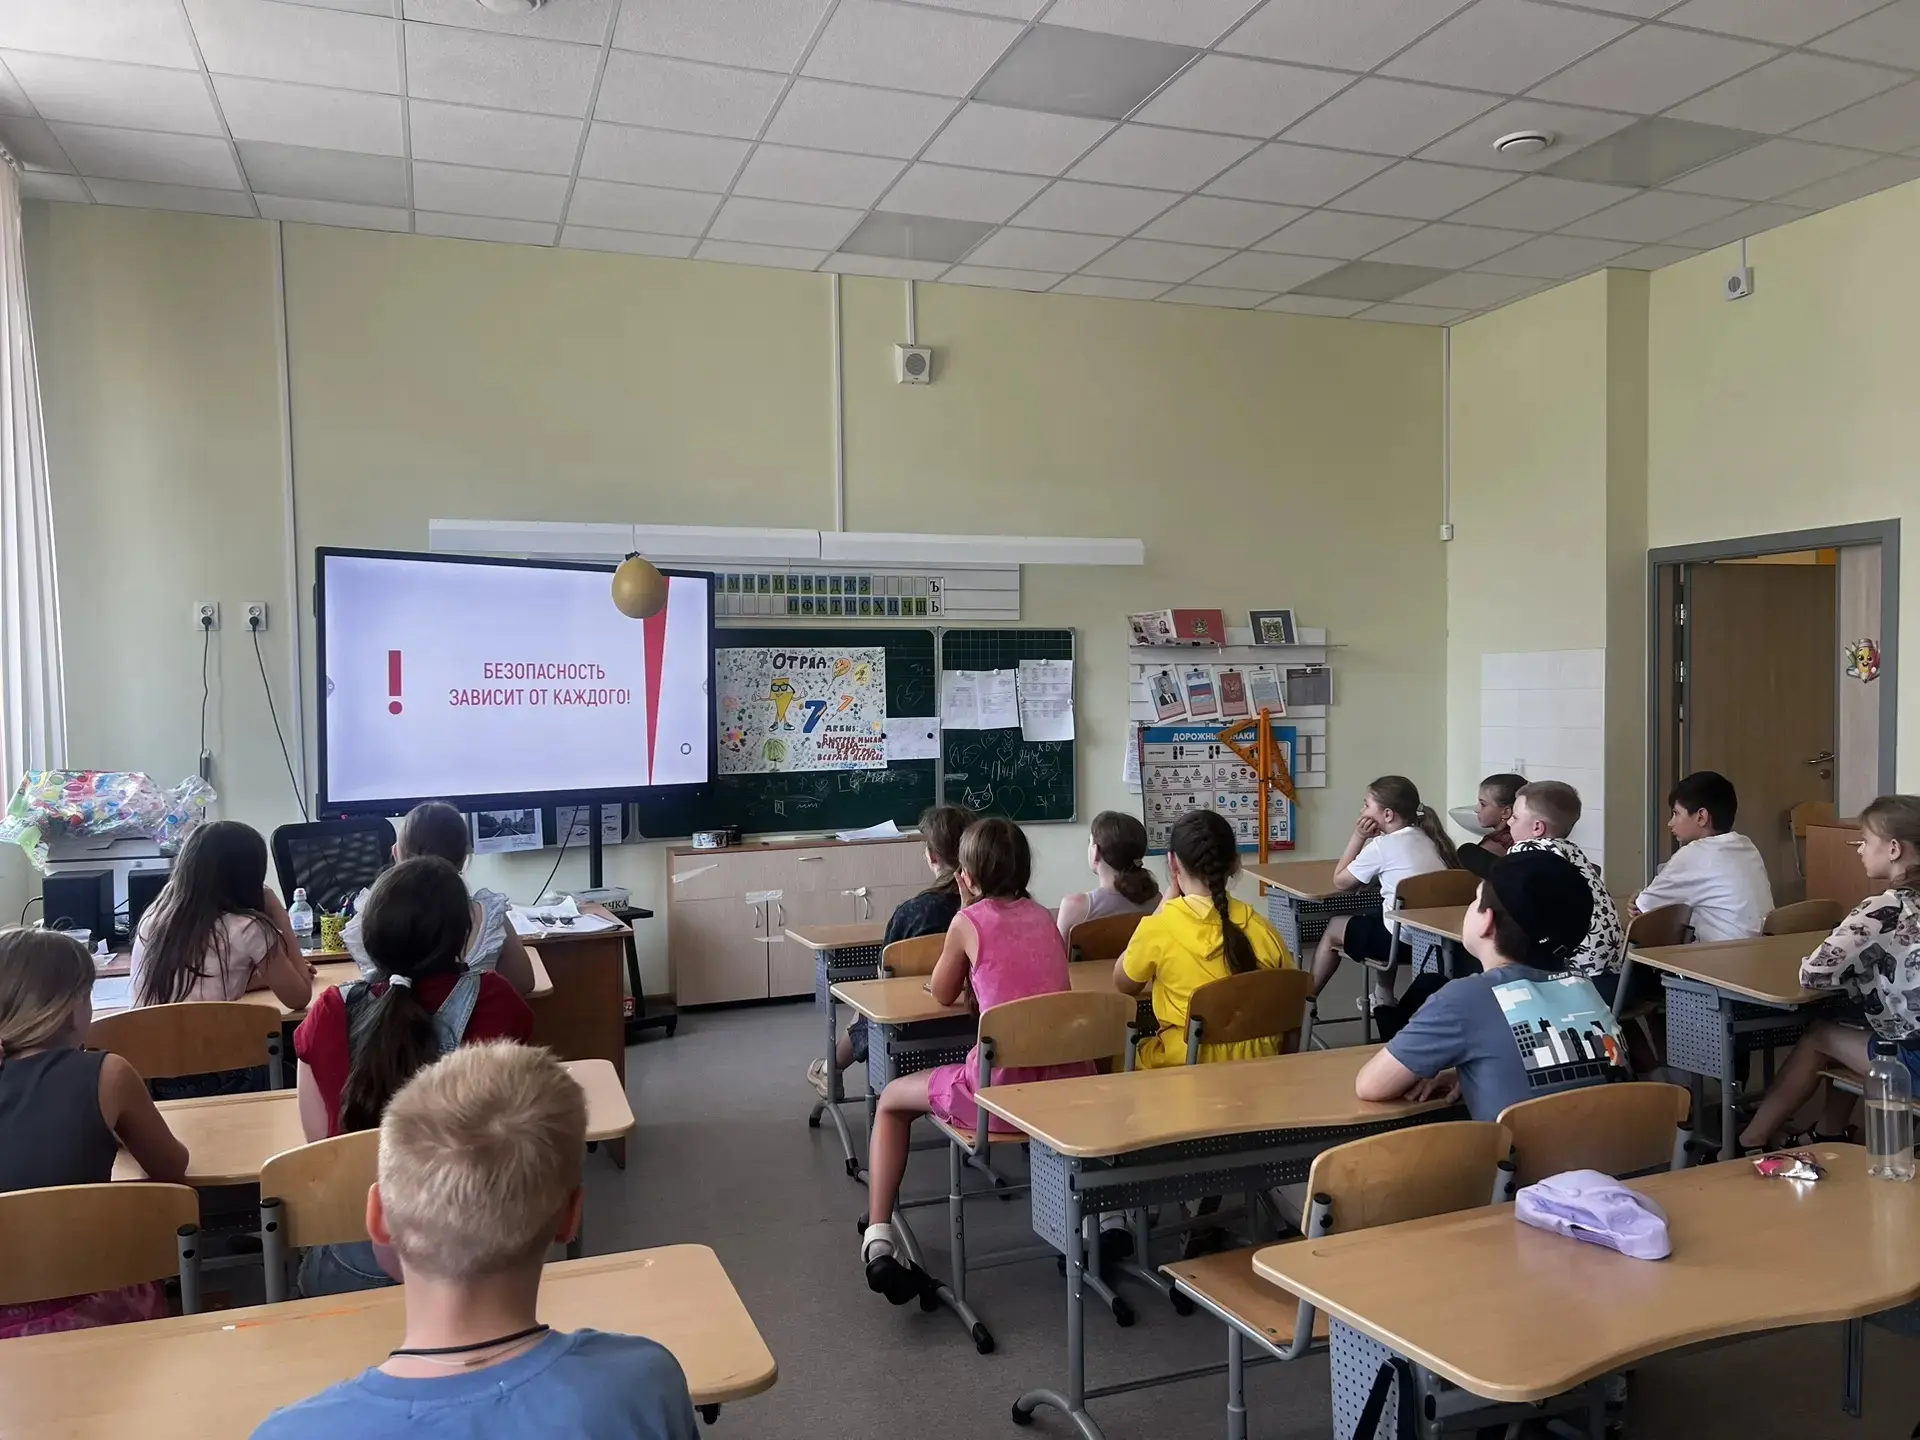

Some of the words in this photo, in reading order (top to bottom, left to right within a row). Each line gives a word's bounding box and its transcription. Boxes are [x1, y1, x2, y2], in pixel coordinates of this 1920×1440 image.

[484, 662, 605, 679] БЕЗОПАСНОСТЬ
[449, 689, 524, 706] ЗАВИСИТ
[529, 689, 548, 705] ОТ
[554, 689, 631, 707] КАЖДОГО!
[803, 701, 827, 733] 7
[1229, 731, 1255, 740] НАКИ
